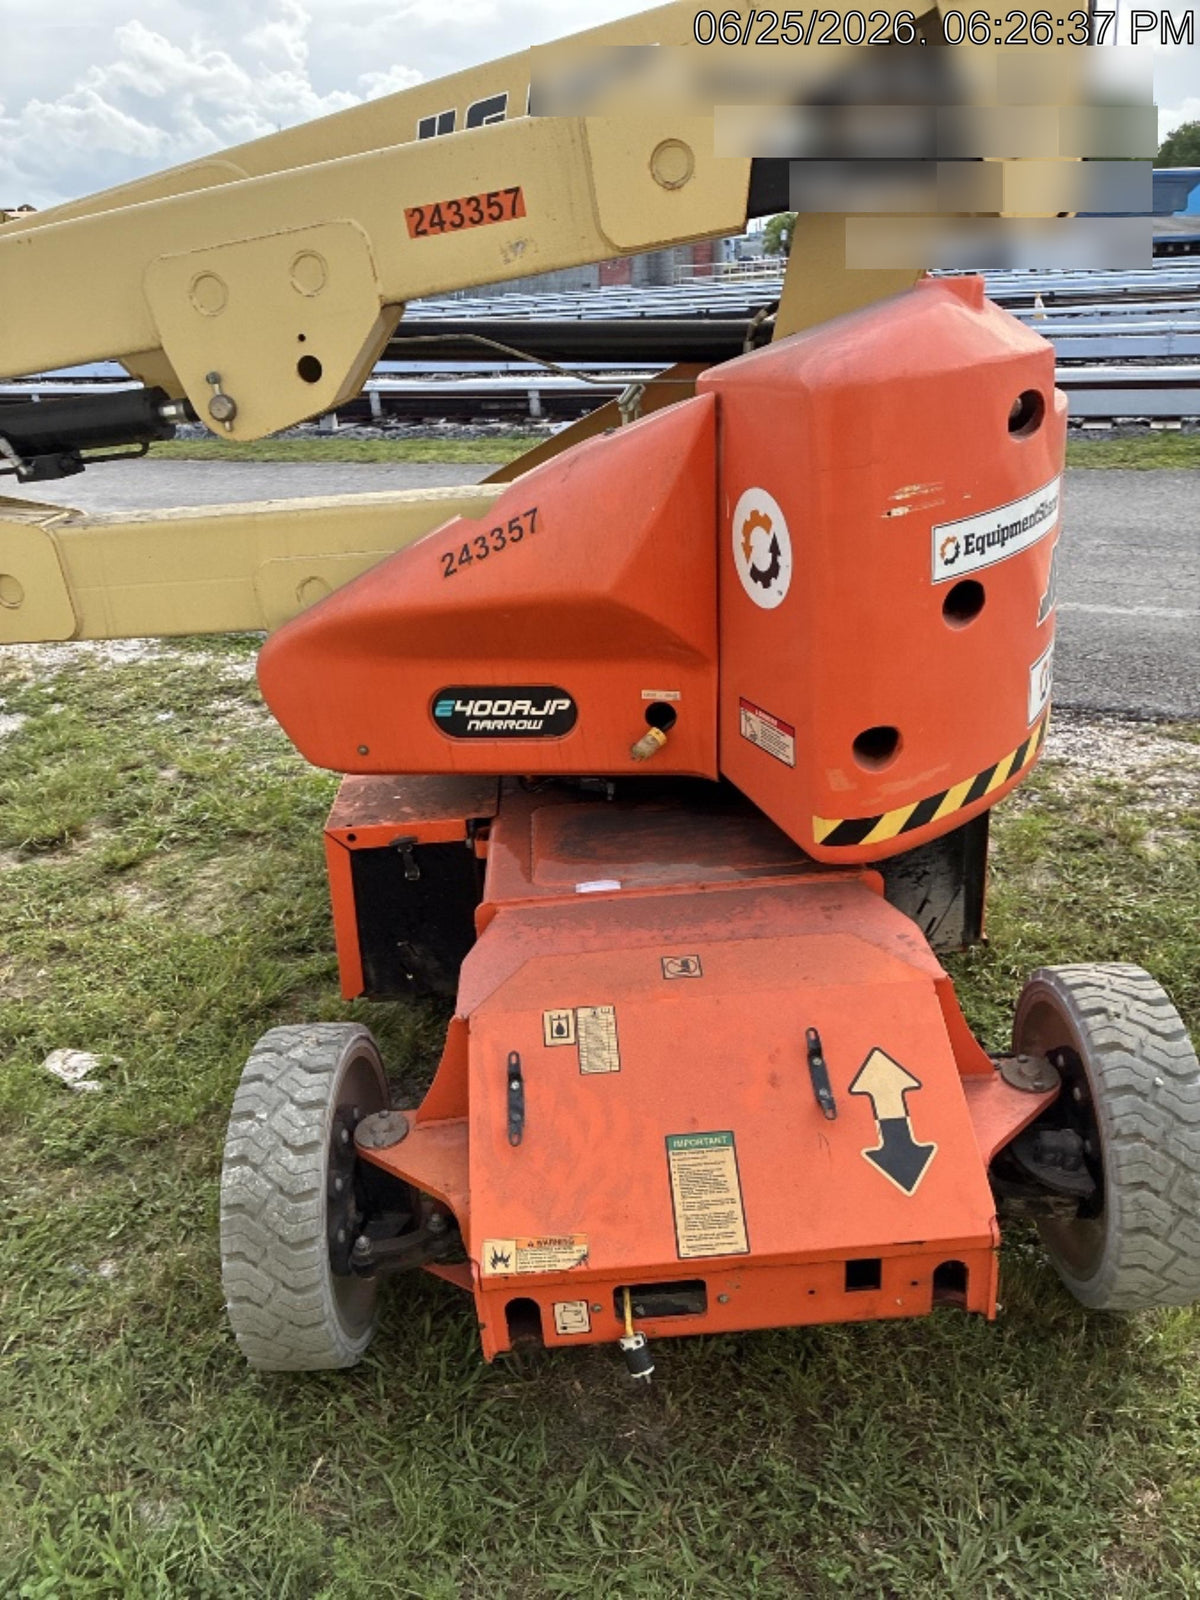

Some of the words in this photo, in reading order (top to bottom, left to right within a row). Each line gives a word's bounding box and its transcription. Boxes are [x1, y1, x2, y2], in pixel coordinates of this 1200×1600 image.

[408, 186, 521, 236] 243357
[441, 507, 538, 578] 243357
[434, 698, 572, 718] E400AJP
[466, 719, 544, 731] NARROW
[672, 1135, 728, 1148] IMPORTANT
